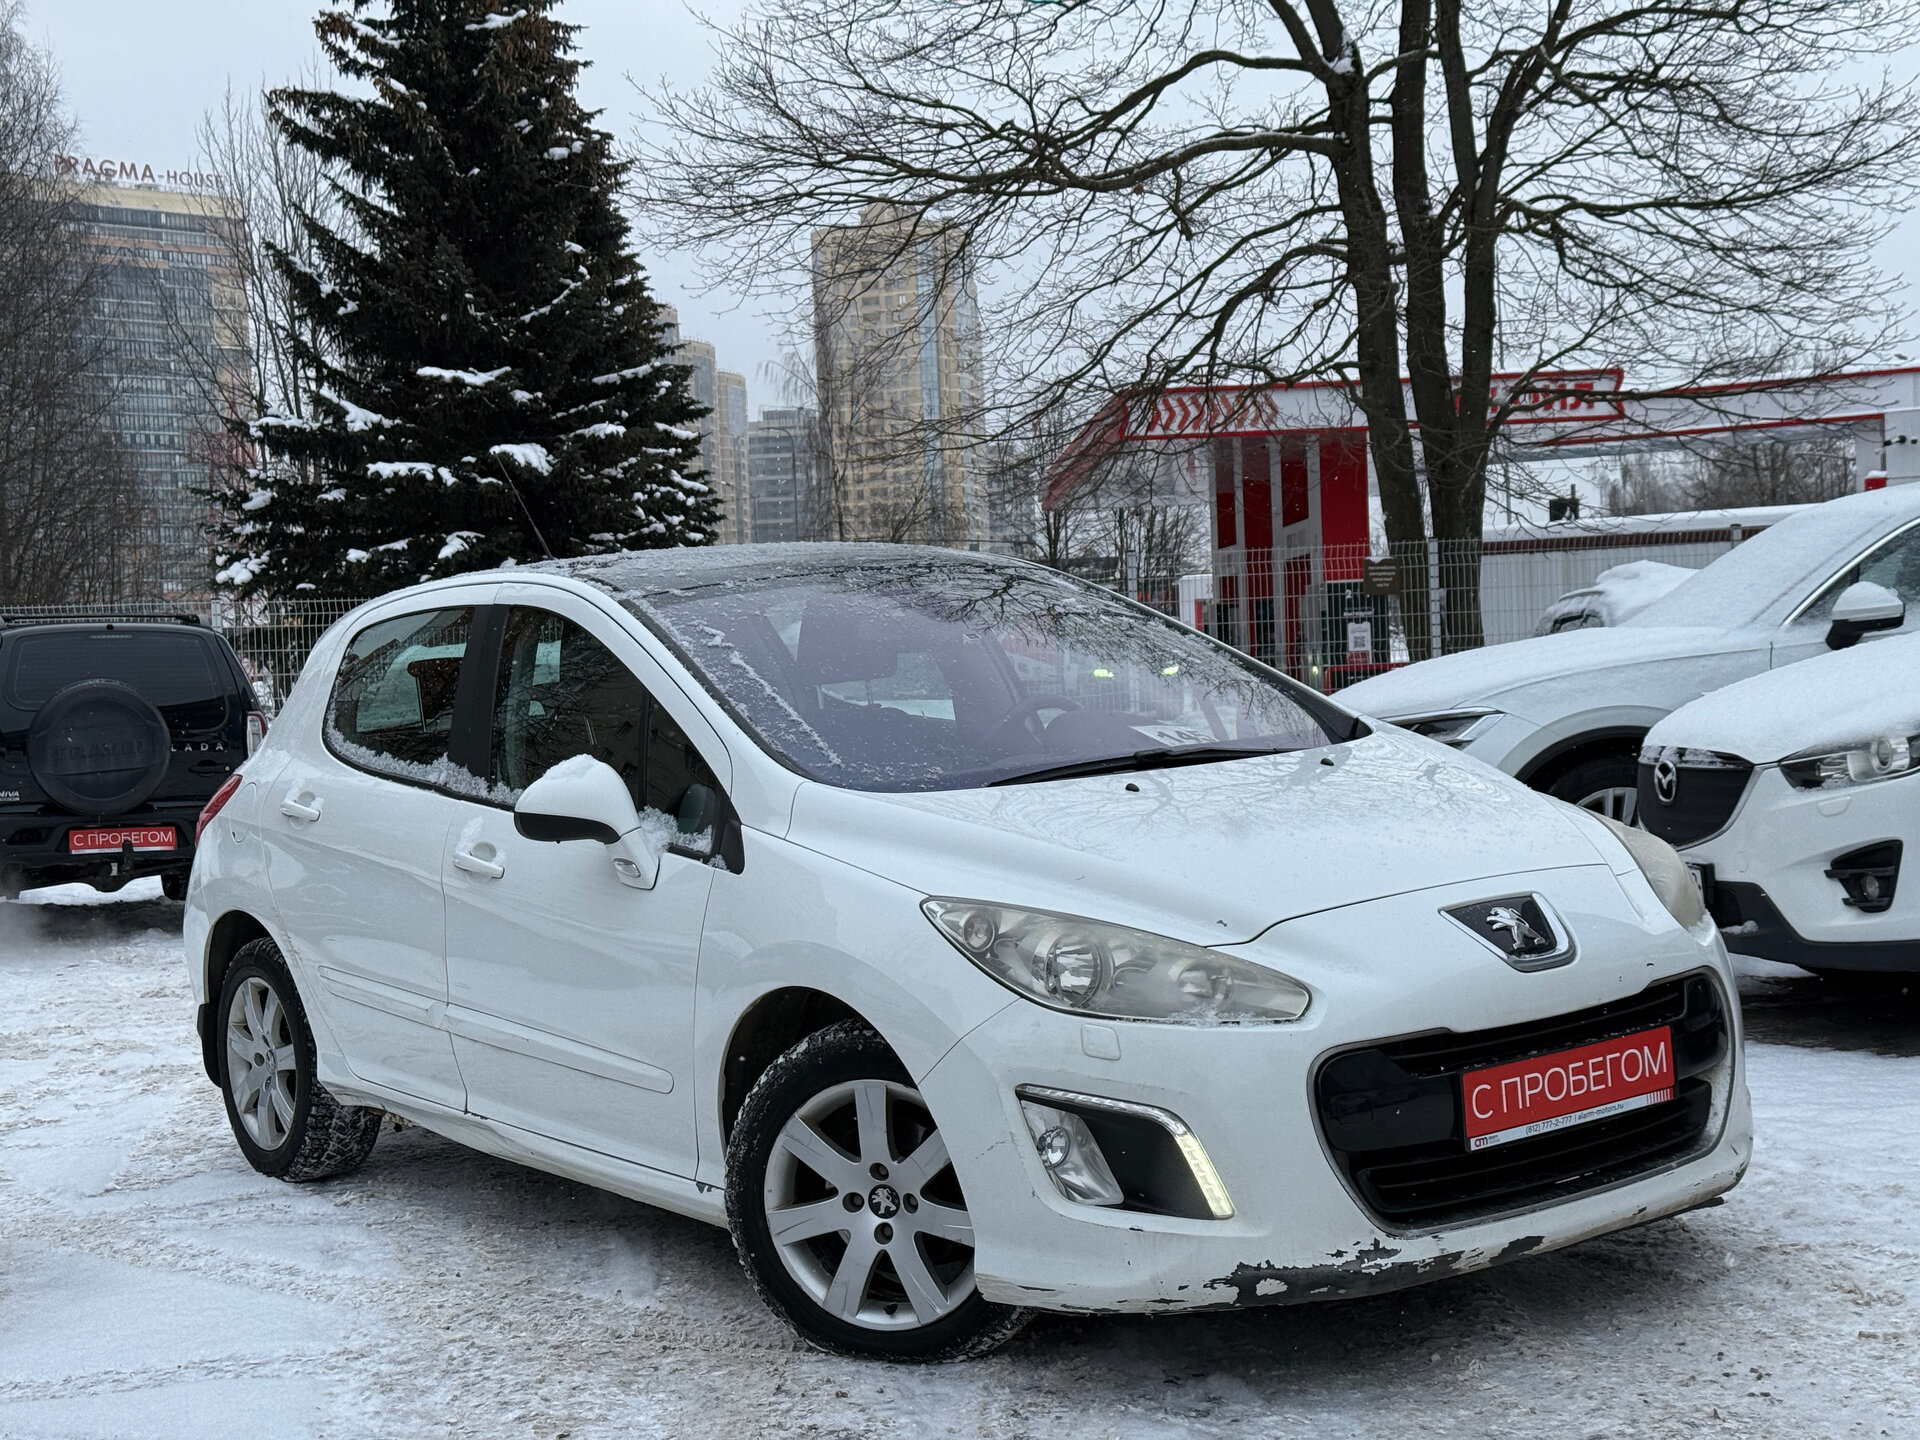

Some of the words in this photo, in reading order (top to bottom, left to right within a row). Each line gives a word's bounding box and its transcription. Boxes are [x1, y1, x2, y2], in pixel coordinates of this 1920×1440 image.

[170, 742, 224, 752] LADA
[73, 834, 84, 846] С
[88, 831, 173, 846] ПРОБЕГОМ
[1472, 1084, 1494, 1119] С
[1501, 1041, 1667, 1113] ПРОБЕГОМ
[1542, 1115, 1573, 1129] 777-2-777
